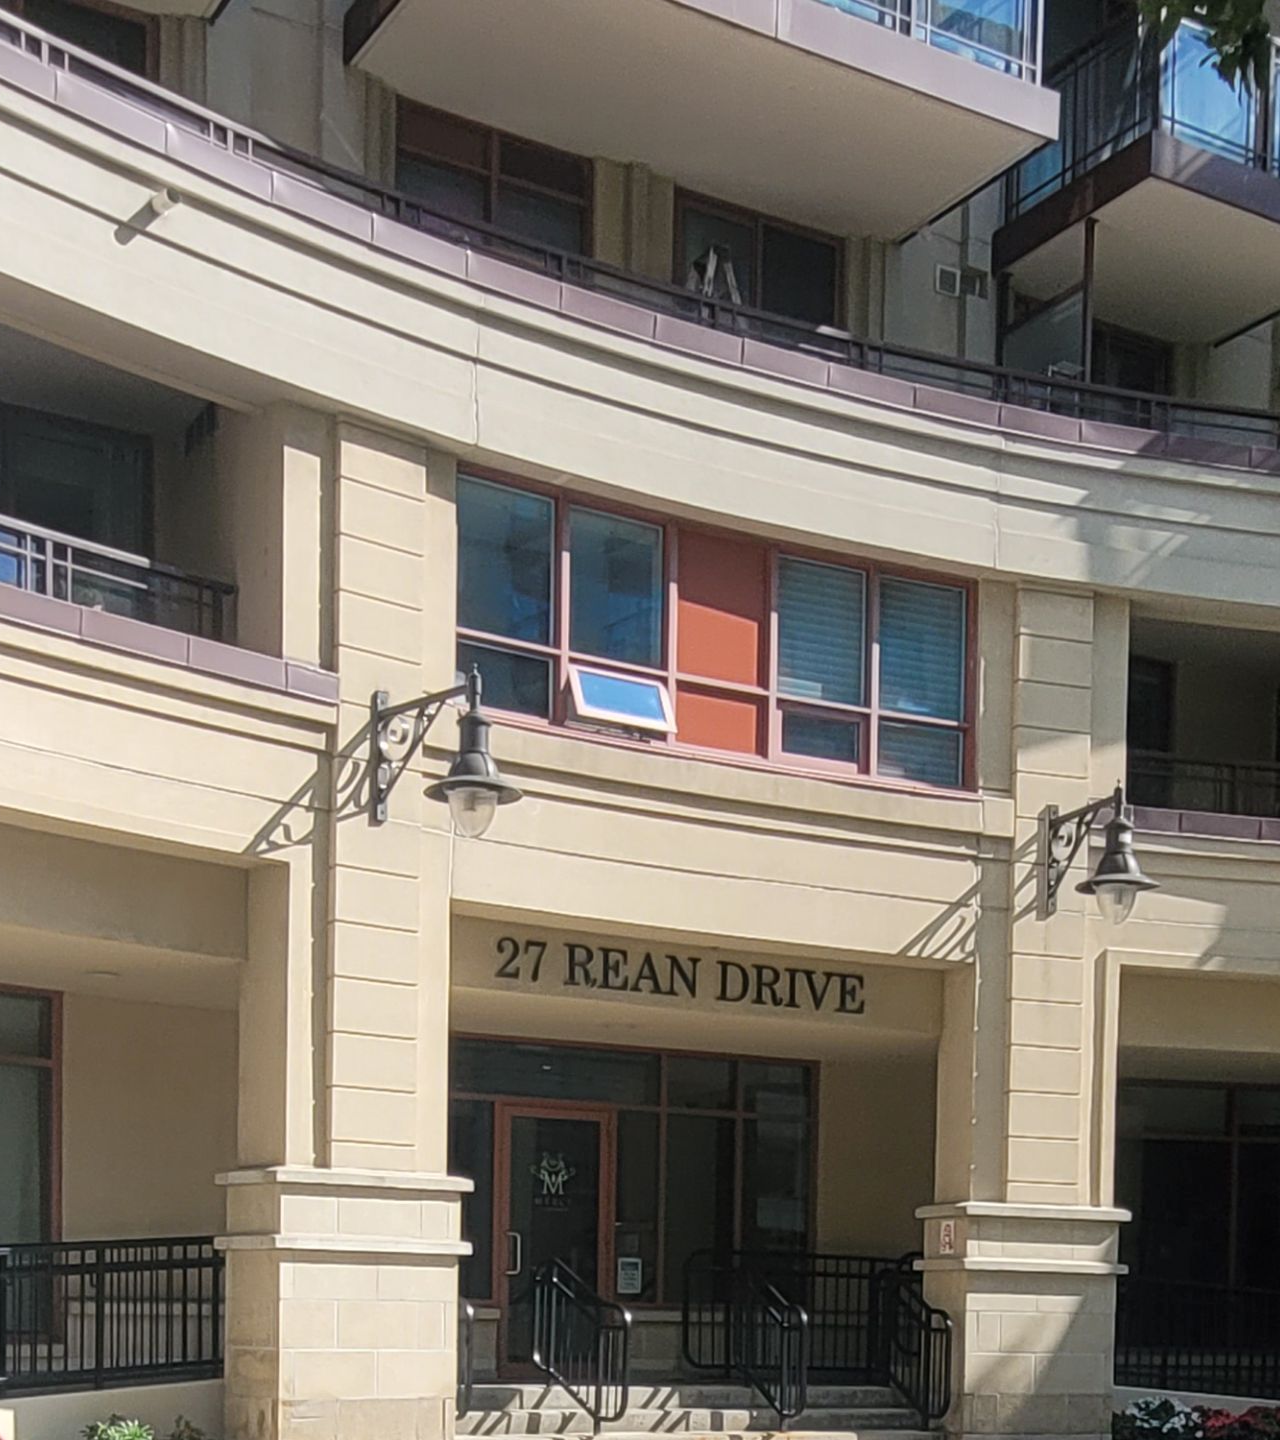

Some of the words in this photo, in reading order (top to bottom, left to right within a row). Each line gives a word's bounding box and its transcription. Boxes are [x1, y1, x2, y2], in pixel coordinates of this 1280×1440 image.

[494, 937, 547, 983] 27
[563, 943, 702, 999] REAN
[715, 960, 865, 1014] DRIVE
